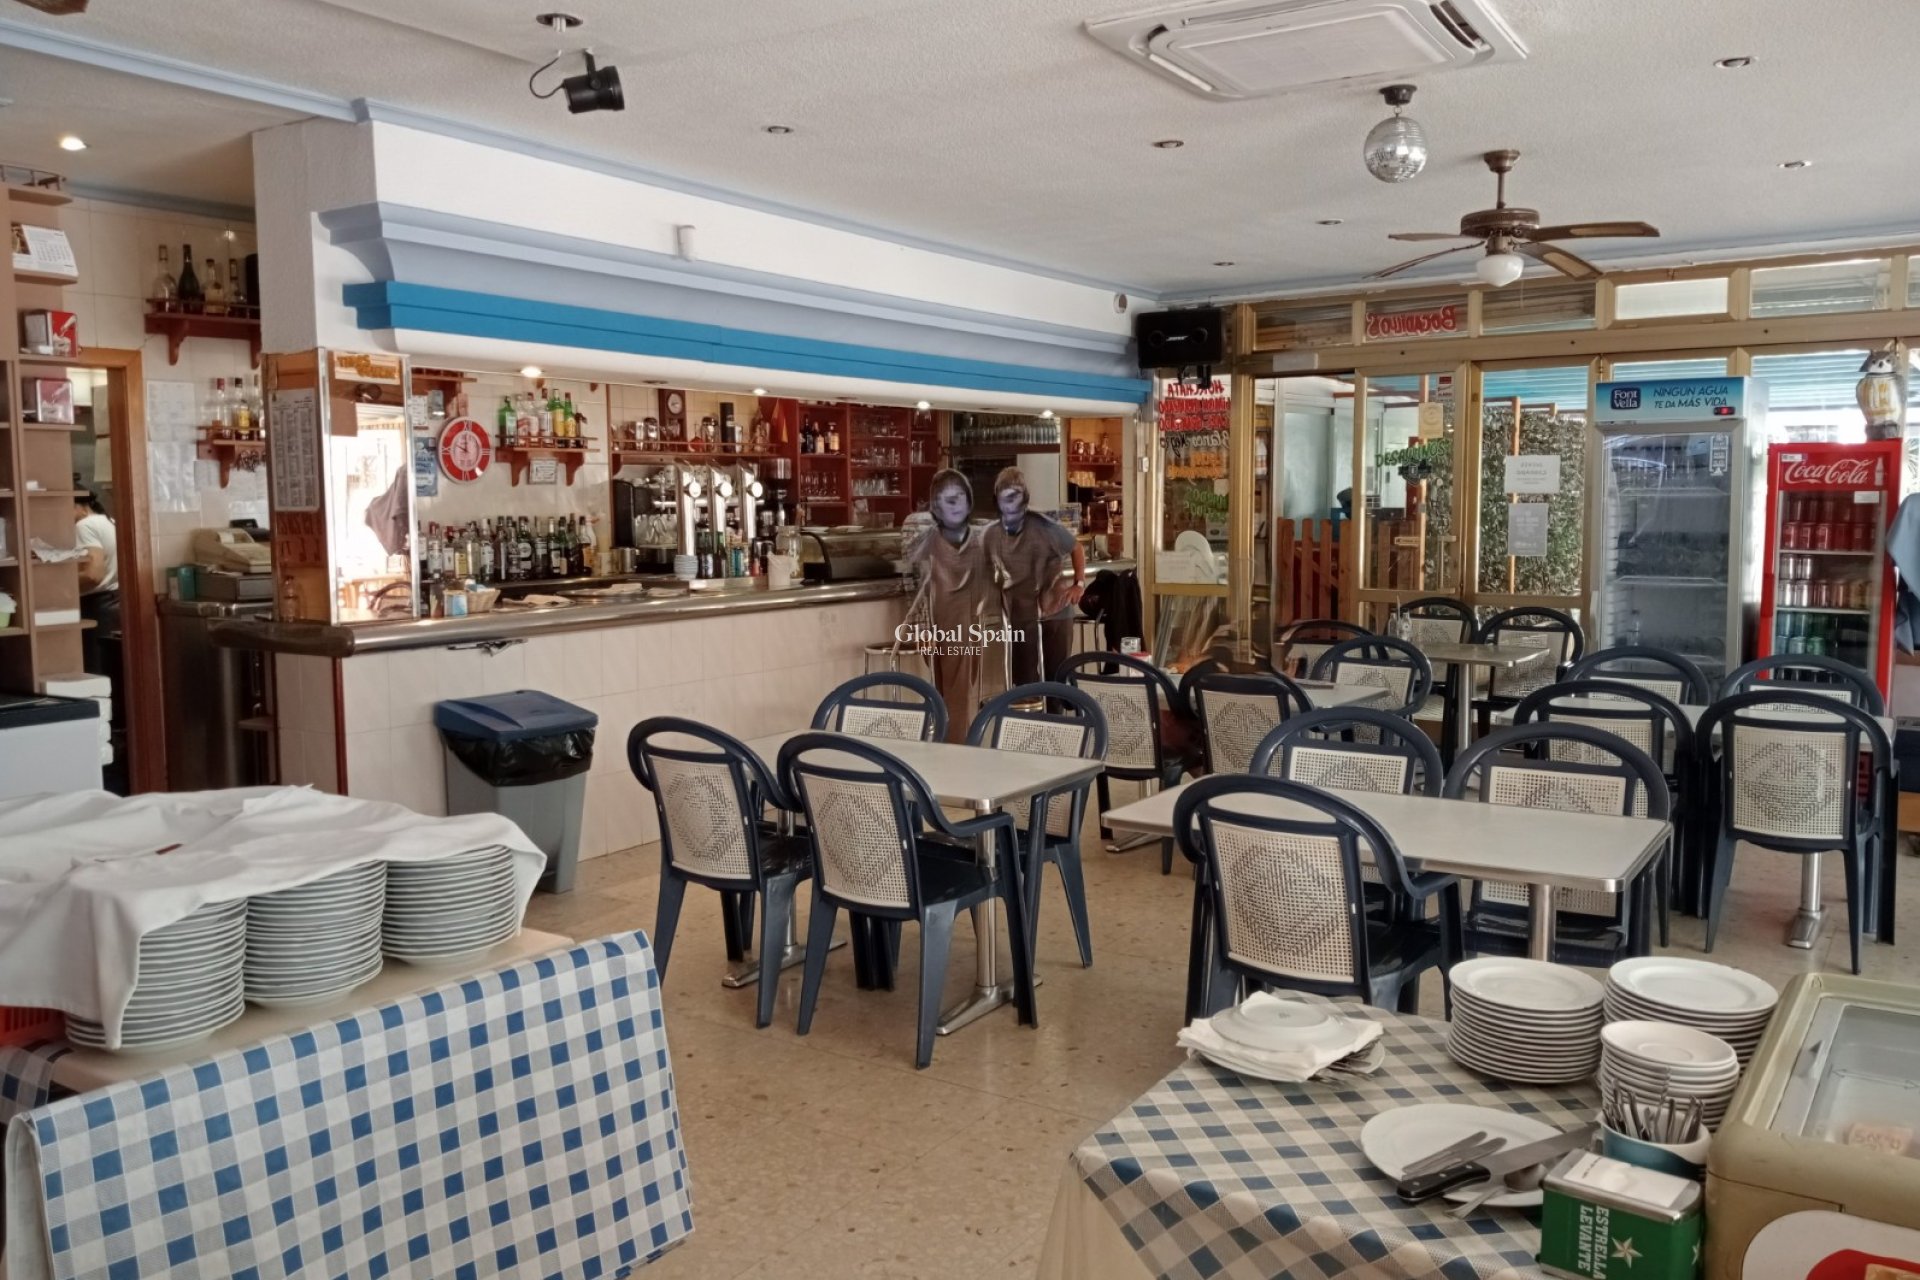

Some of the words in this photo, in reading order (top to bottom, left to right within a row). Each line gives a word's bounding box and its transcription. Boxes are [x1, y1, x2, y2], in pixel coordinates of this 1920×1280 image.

[1614, 389, 1638, 400] Font
[1699, 384, 1729, 396] AGUA
[1614, 398, 1638, 409] Vella
[1654, 400, 1665, 409] TE
[1664, 399, 1676, 409] DA
[1704, 395, 1728, 407] VIDA
[1785, 459, 1874, 484] Coca-Cola
[1578, 1205, 1593, 1272] LEVANTE
[1593, 1206, 1609, 1280] ESTRELLA
